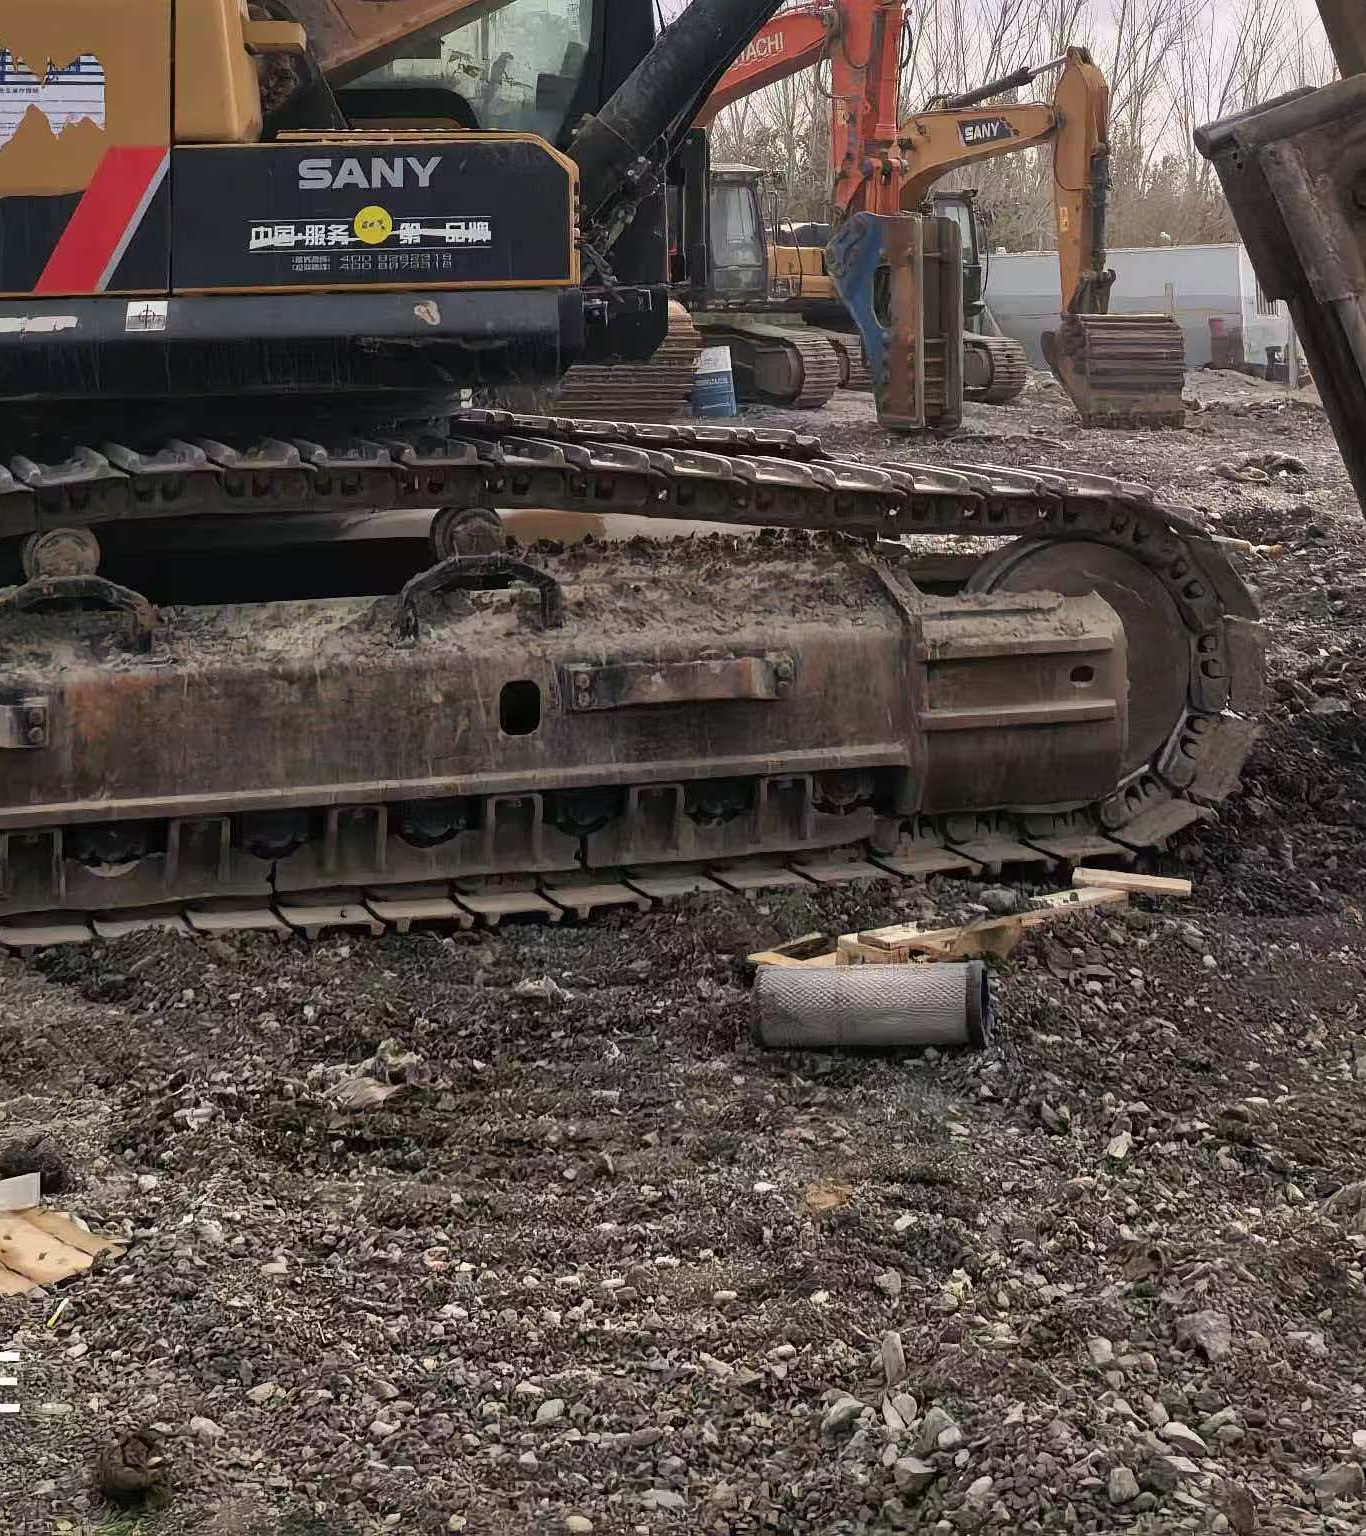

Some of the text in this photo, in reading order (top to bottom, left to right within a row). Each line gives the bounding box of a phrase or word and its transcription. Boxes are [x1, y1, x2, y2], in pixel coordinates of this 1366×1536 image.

[739, 31, 785, 63] ACHI
[964, 121, 1000, 141] SANY
[298, 156, 444, 190] SANY
